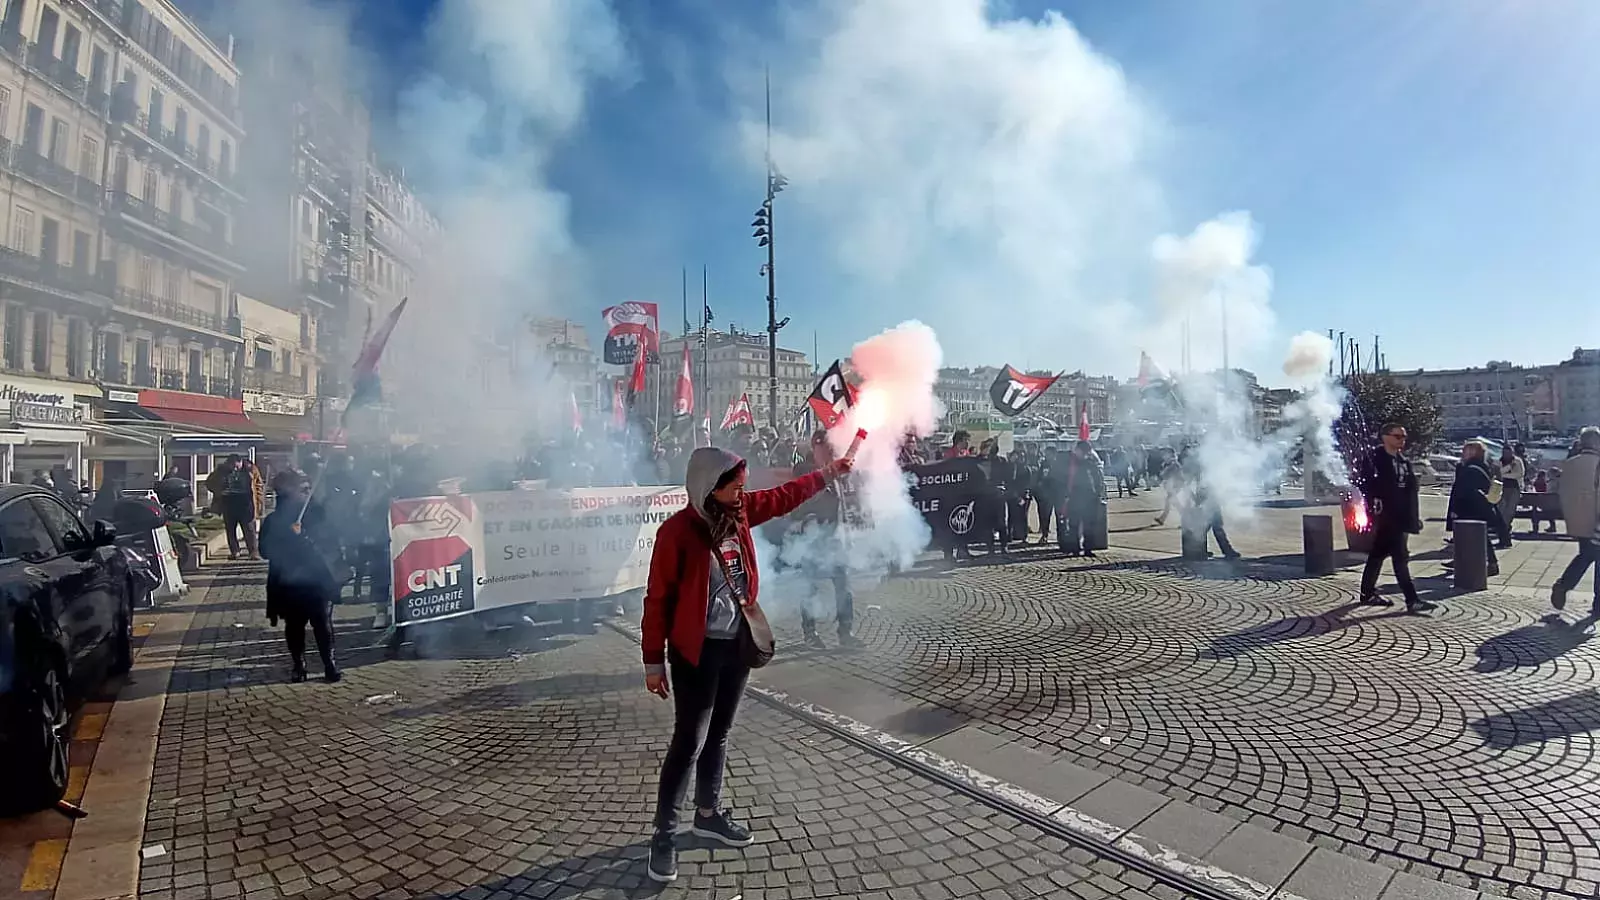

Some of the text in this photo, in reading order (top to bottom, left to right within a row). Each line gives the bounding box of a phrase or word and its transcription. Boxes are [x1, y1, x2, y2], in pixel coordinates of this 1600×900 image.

[921, 473, 963, 485] SOCIALE
[644, 493, 687, 507] DROITS
[484, 520, 504, 535] ET
[509, 519, 532, 532] EN
[537, 516, 605, 531] GAGNER
[607, 513, 622, 526] DE
[503, 544, 561, 561] Seule
[407, 564, 462, 593] CNT
[407, 588, 464, 608] SOLIDARITÉ
[411, 600, 461, 618] OUVRIÈRE
